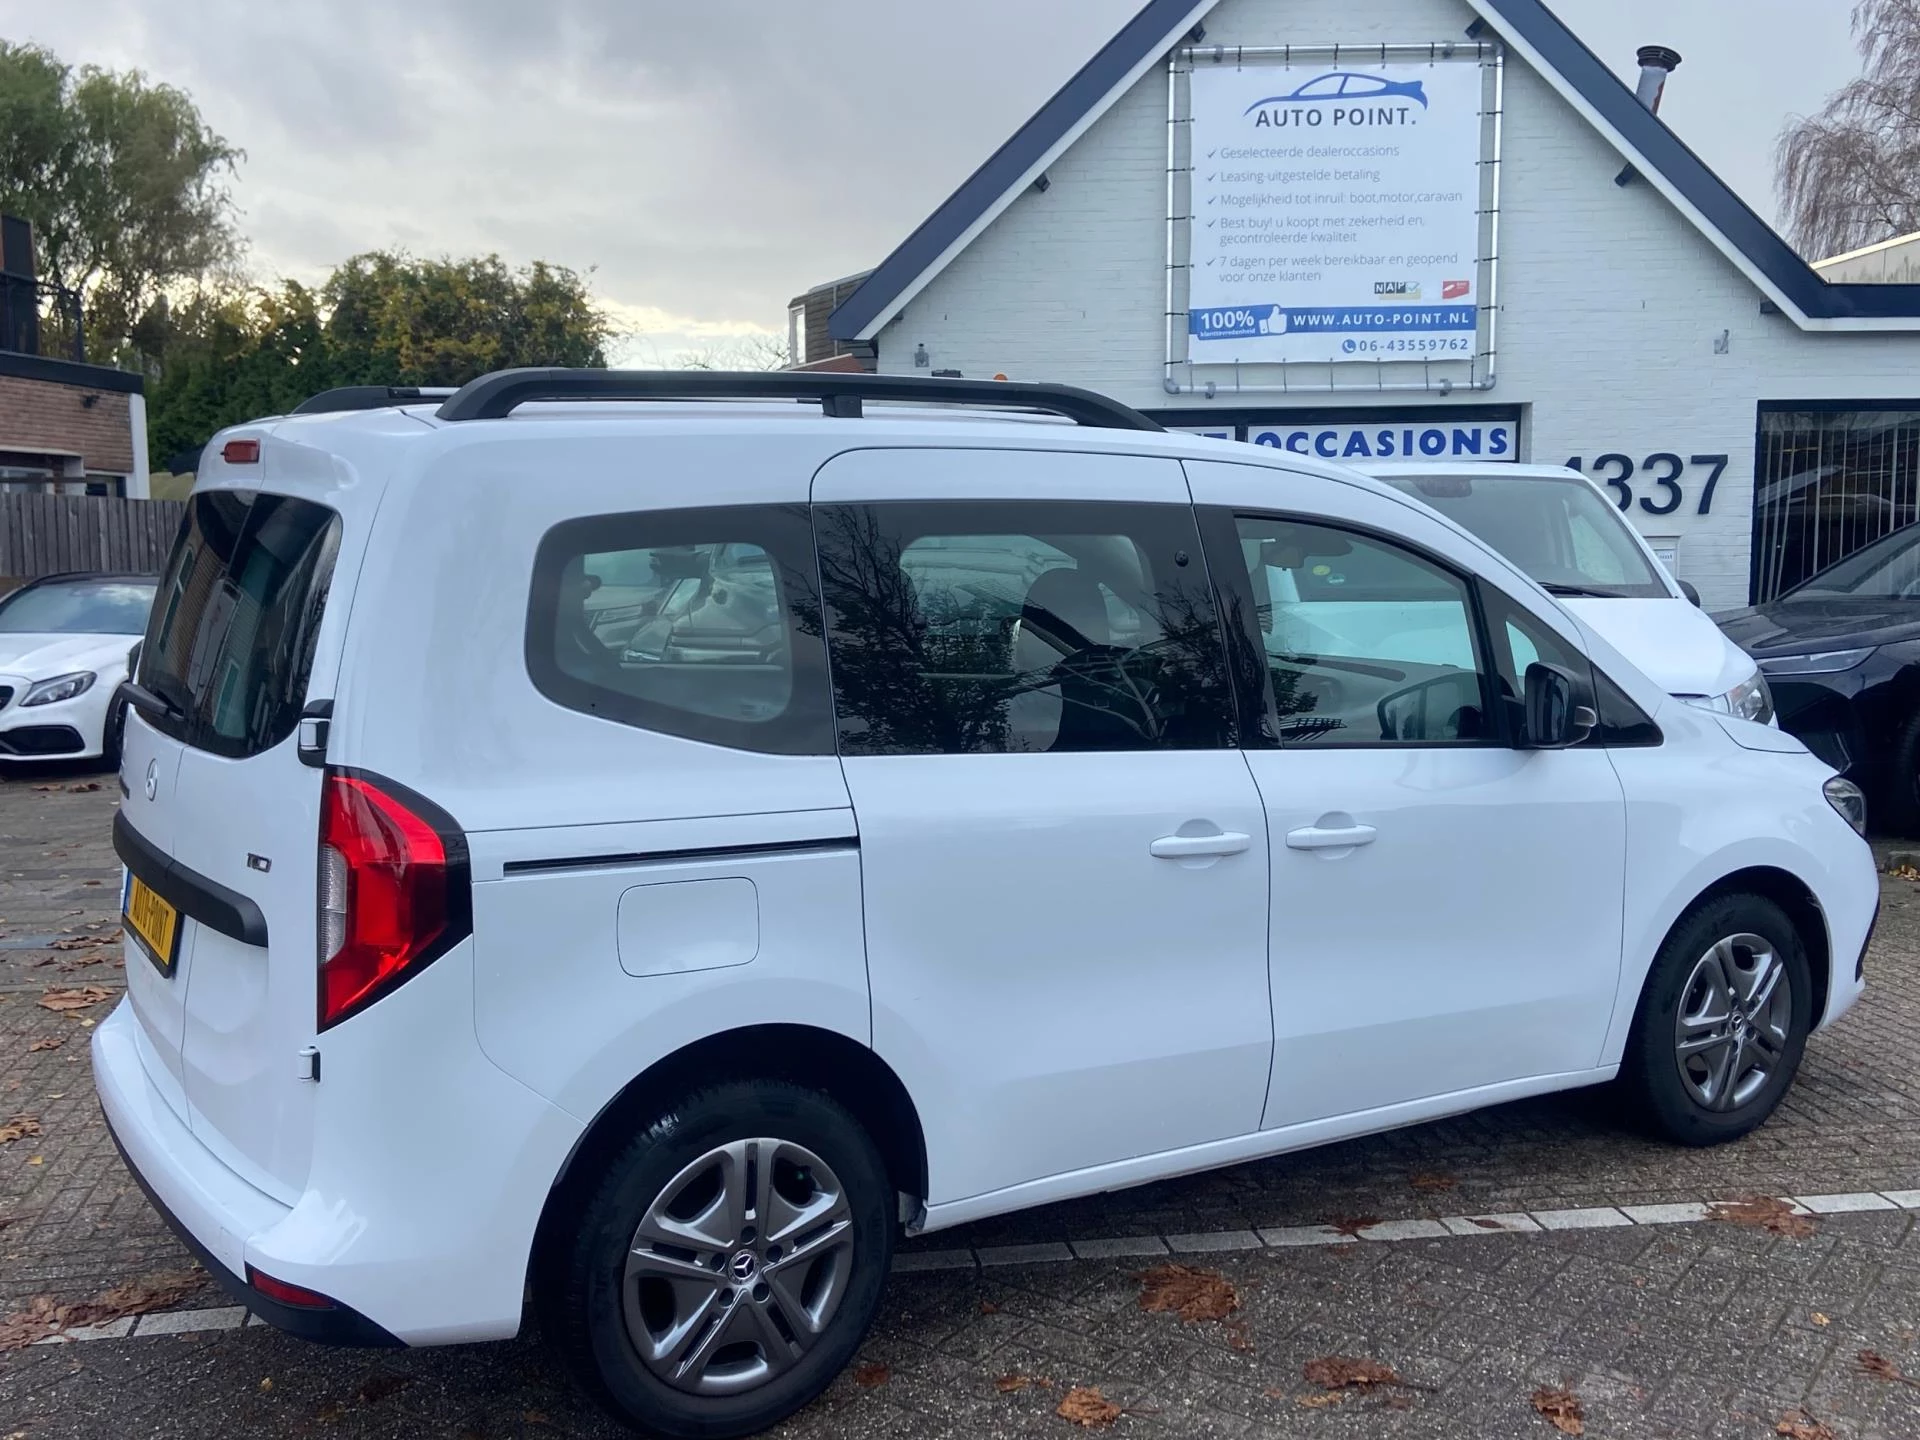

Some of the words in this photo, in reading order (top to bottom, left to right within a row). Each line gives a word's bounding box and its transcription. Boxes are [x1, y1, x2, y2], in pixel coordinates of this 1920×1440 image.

[1255, 109, 1322, 127] AUTO
[1220, 146, 1304, 159] Geselecteerde
[1306, 144, 1400, 157] dealeroccasions
[1334, 169, 1380, 183] betaling
[1220, 194, 1292, 208] Mogelijkheid
[1295, 194, 1311, 204] tot
[1220, 218, 1245, 229] Best
[1275, 219, 1284, 228] u
[1286, 217, 1319, 230] koopt
[1322, 217, 1345, 227] met
[1348, 214, 1405, 227] zekerheid
[1219, 233, 1308, 248] gecontroleerde
[1311, 231, 1357, 243] kwaliteit
[1220, 256, 1227, 266] 7
[1230, 256, 1266, 270] dagen
[1269, 257, 1288, 269] per
[1291, 255, 1321, 266] week
[1324, 253, 1386, 266] bereikbaar
[1388, 255, 1404, 265] en
[1406, 252, 1458, 268] geopend
[1219, 274, 1245, 283] voor
[1248, 272, 1276, 282] onze
[1280, 270, 1321, 282] klanten
[1375, 282, 1406, 294] NAP
[1200, 309, 1255, 330] 100%
[1293, 312, 1469, 326] WWW.AUTO-POINT.NL
[1359, 339, 1468, 352] 06-43559762
[1255, 428, 1508, 458] OCCASIONS
[1564, 453, 1729, 515] 337
